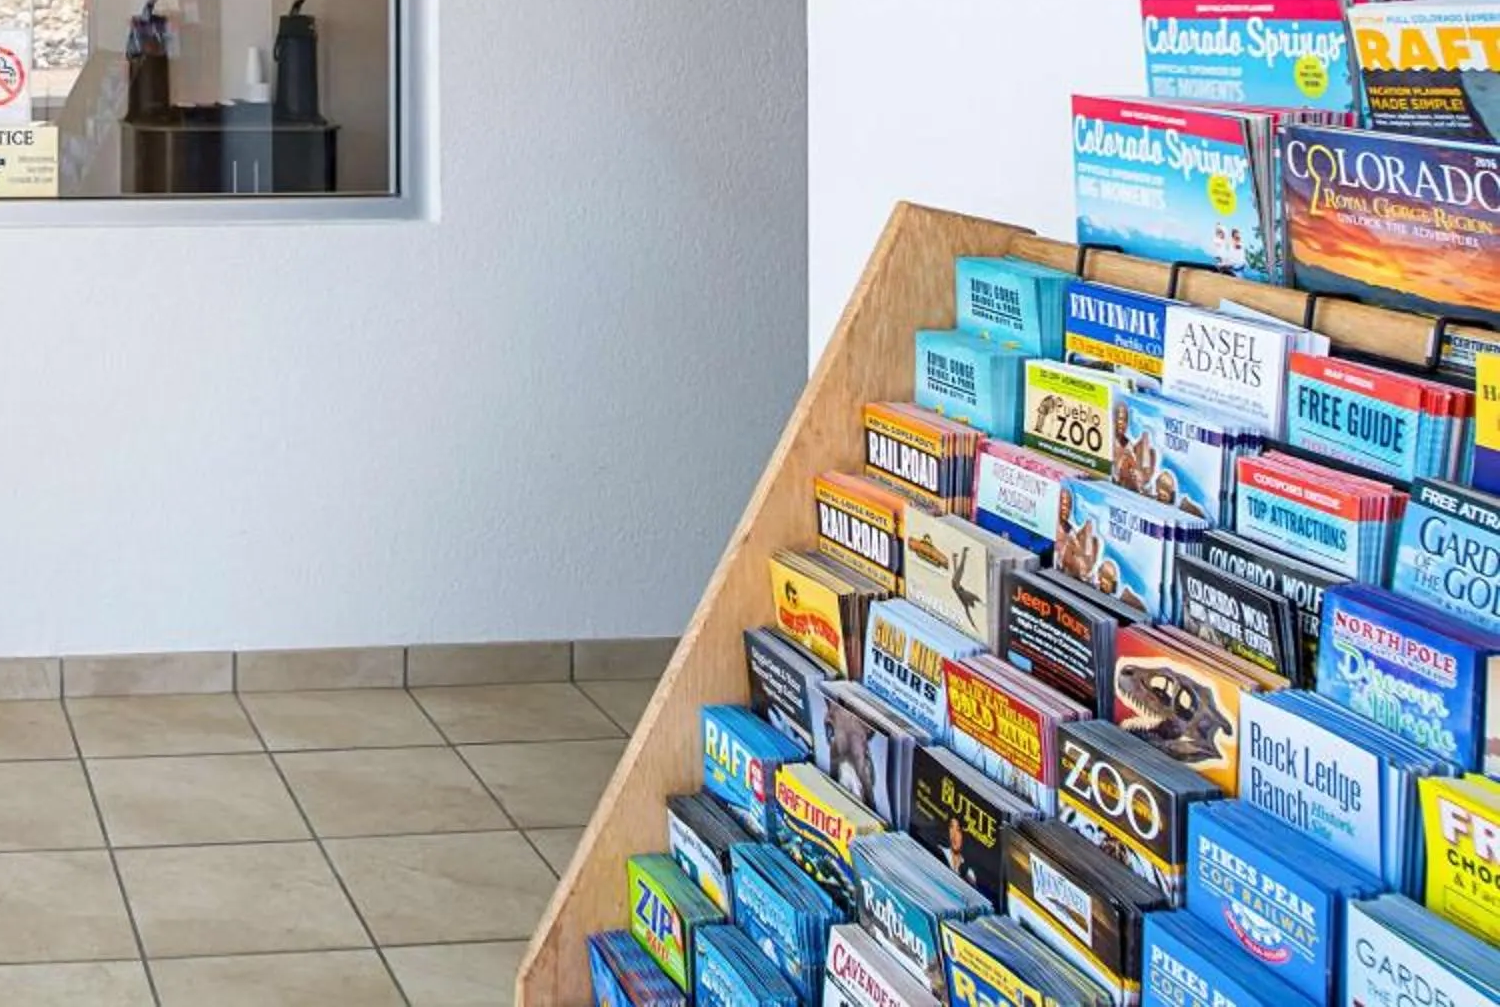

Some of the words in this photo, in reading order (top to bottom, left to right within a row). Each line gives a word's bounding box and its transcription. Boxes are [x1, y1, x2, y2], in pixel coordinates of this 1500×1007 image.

[1145, 15, 1244, 56] Colorado
[1247, 16, 1345, 67] Springs
[1355, 26, 1500, 72] RAFT
[1370, 98, 1407, 110] MADE
[1074, 114, 1165, 164] Colorado
[1165, 129, 1248, 191] Springs
[1287, 140, 1500, 217] COLORADO
[1373, 197, 1430, 223] GORGE
[1180, 347, 1262, 388] ADAMS
[1181, 322, 1262, 363] ANSEL
[1054, 397, 1101, 425] Pueblo
[1056, 416, 1102, 451] ZOO
[1164, 416, 1184, 437] VISIT
[1298, 385, 1342, 432] FREE
[1349, 398, 1405, 454] GUIDE
[868, 430, 938, 493] RAILROAD
[1165, 432, 1189, 454] TODAY
[1109, 505, 1129, 525] VISIT
[1246, 496, 1269, 523] TOP
[1271, 503, 1348, 552] ATTRACTIONS
[1421, 486, 1458, 513] FREE
[820, 502, 889, 566] RAILROAD
[1109, 524, 1133, 543] TODAY
[1187, 576, 1239, 621] COLORADO
[1282, 573, 1324, 613] WOLF
[1414, 568, 1441, 590] THE
[1012, 587, 1051, 618] Jeep
[1055, 605, 1091, 640] Tours
[873, 614, 906, 663] GOLD
[908, 636, 943, 687] MINE
[1335, 611, 1400, 651] NORTH
[1407, 640, 1455, 675] POLE
[872, 648, 937, 702] TOURS
[1064, 740, 1160, 840] ZOO
[1250, 720, 1297, 779] Rock
[1304, 746, 1362, 813] Ledge
[941, 776, 996, 840] BUTTE
[1251, 766, 1309, 830] Ranch
[1199, 835, 1257, 885] PIKES
[1261, 874, 1316, 927] PEAK
[1199, 860, 1234, 894] COG
[1241, 887, 1317, 947] RAILWAY
[635, 878, 674, 942] ZIP
[1150, 945, 1208, 1001] PIKES
[1151, 969, 1185, 1005] COG
[1356, 938, 1455, 1007] GARDE
